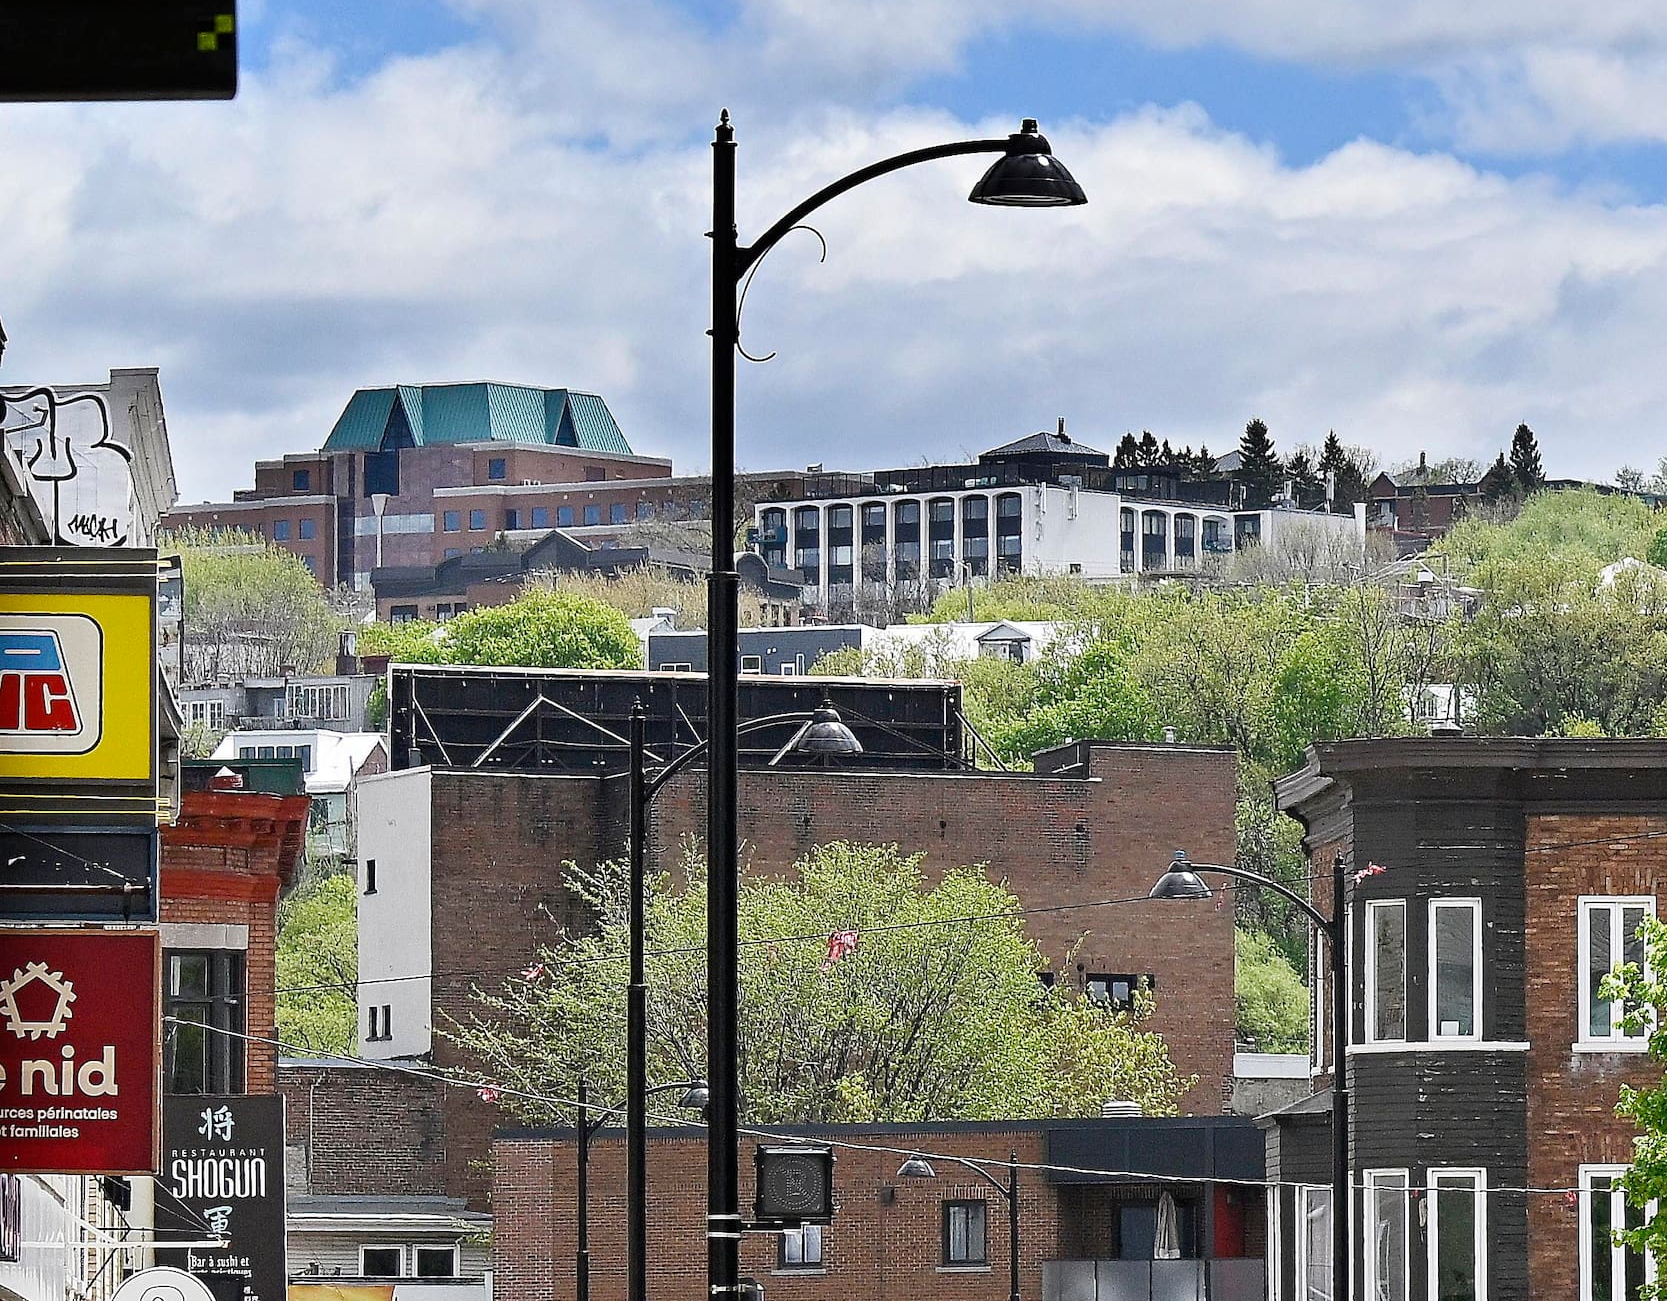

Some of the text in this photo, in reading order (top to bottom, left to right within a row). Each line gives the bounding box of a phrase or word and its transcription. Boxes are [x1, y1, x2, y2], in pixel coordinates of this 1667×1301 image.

[21, 1044, 119, 1097] nid
[37, 1106, 118, 1123] périnatales
[10, 1124, 80, 1139] familiales
[171, 1147, 266, 1158] RESTAURANT
[171, 1157, 266, 1199] SHOGUN
[191, 1254, 251, 1268] Bar à sushi et
